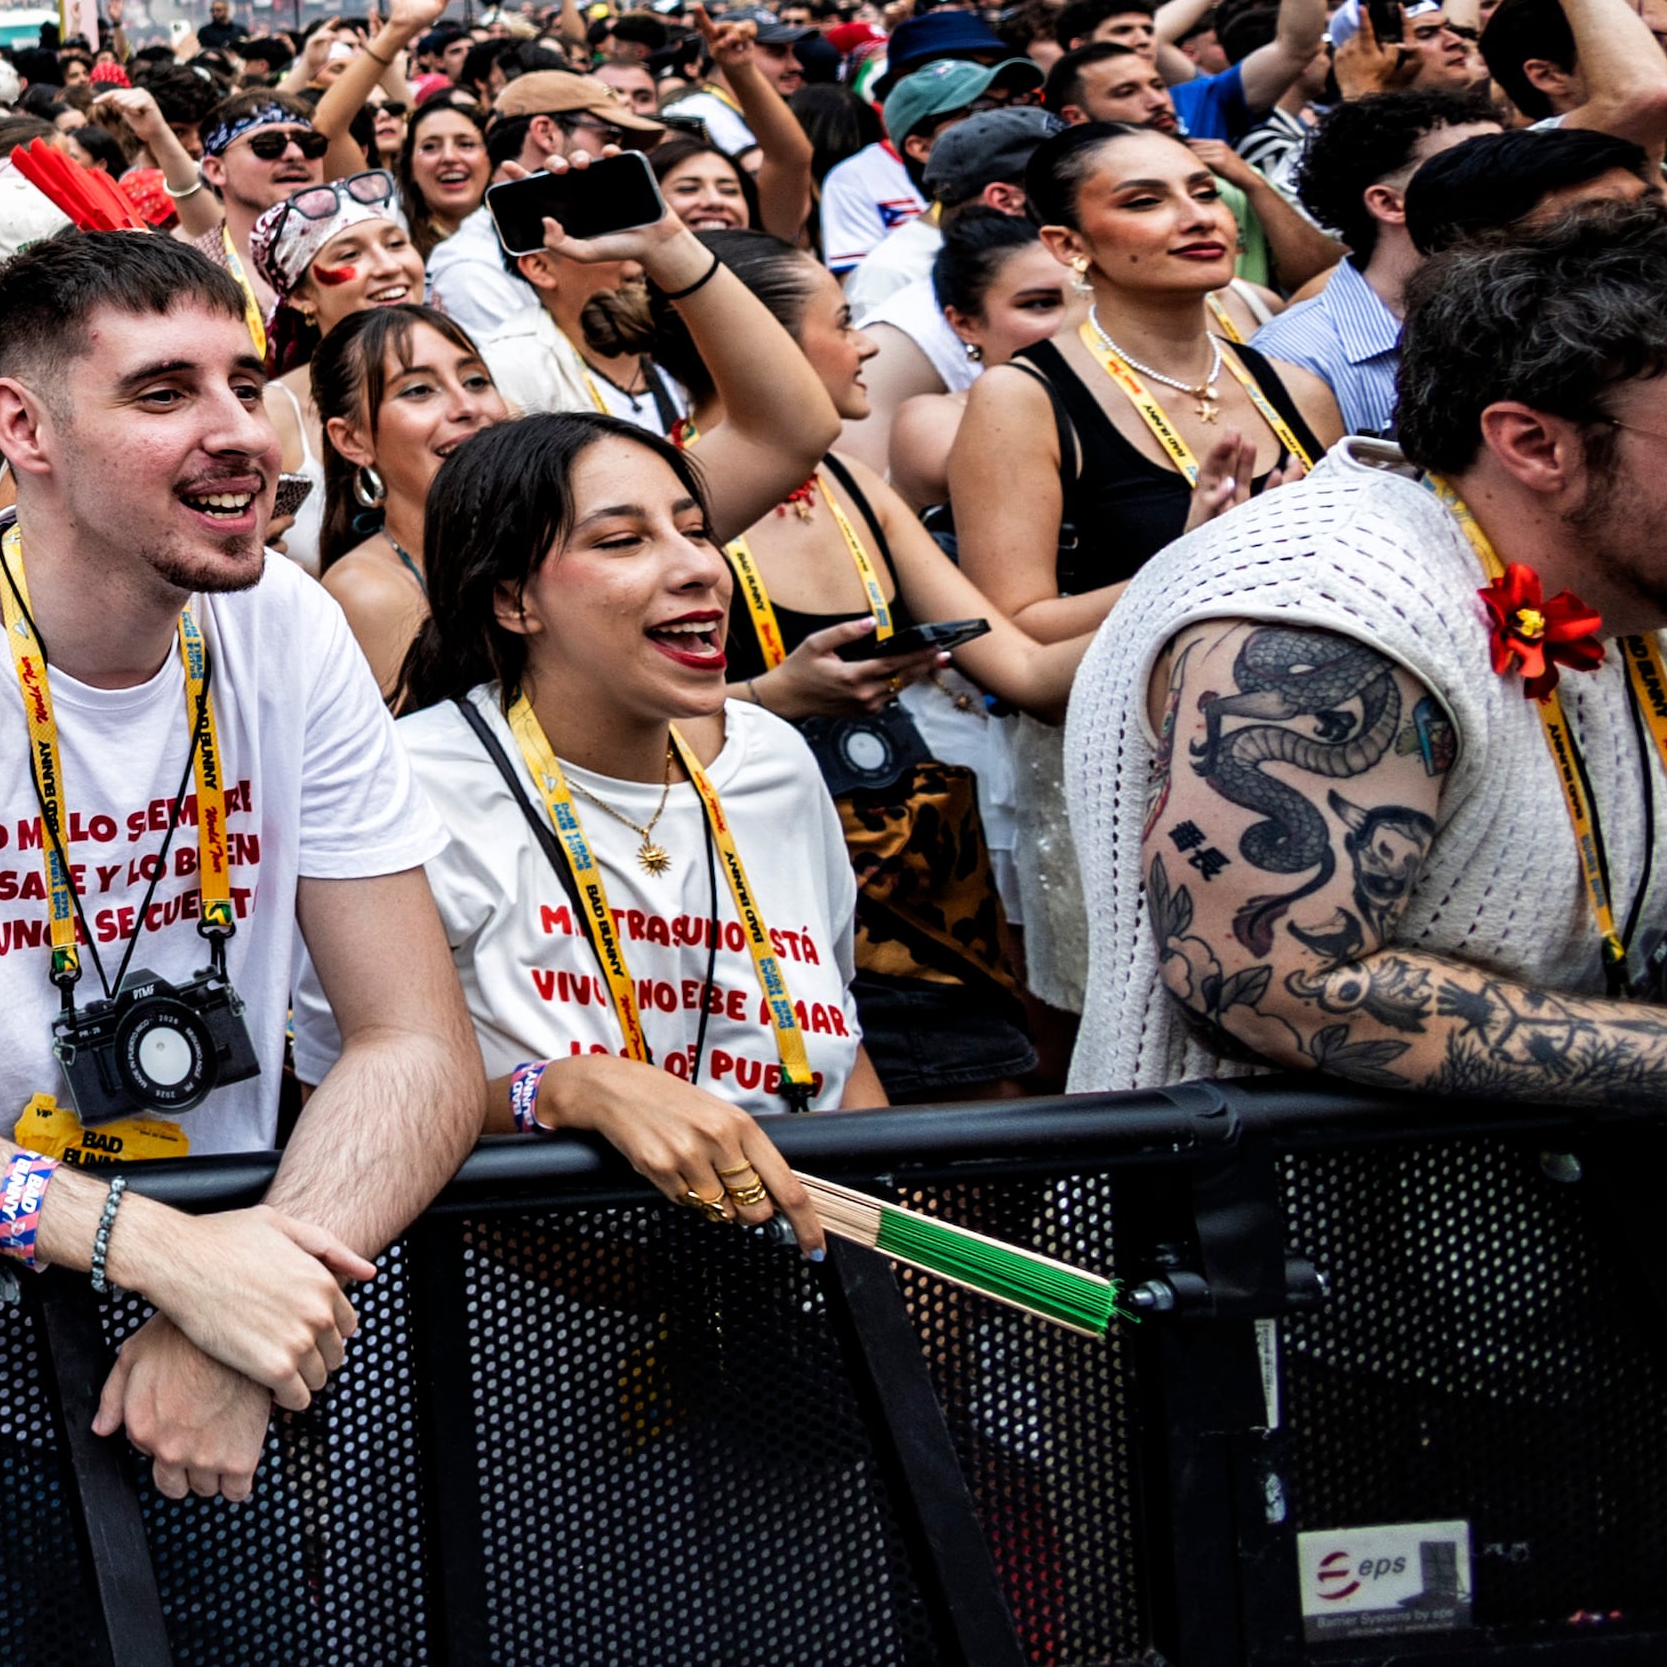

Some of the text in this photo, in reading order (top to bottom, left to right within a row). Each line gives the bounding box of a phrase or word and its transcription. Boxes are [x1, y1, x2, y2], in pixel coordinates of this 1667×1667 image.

[38, 741, 55, 795] BUNNY
[200, 734, 217, 790] BUNNY
[18, 813, 118, 850] MLO
[96, 866, 122, 893] Y
[724, 851, 764, 943] BAD BUNNY
[95, 906, 136, 943] SE
[586, 885, 624, 978] BAD BUNNY
[769, 926, 820, 966] STÁ
[132, 984, 156, 1001] DTMF
[36, 1108, 53, 1119] VIP
[512, 1080, 524, 1116] BAD
[522, 1071, 538, 1126] BUNNY
[82, 1130, 124, 1154] BAD
[2, 1158, 33, 1221] BUNNY
[21, 1173, 45, 1214] BAD
[1358, 1556, 1407, 1581] eps
